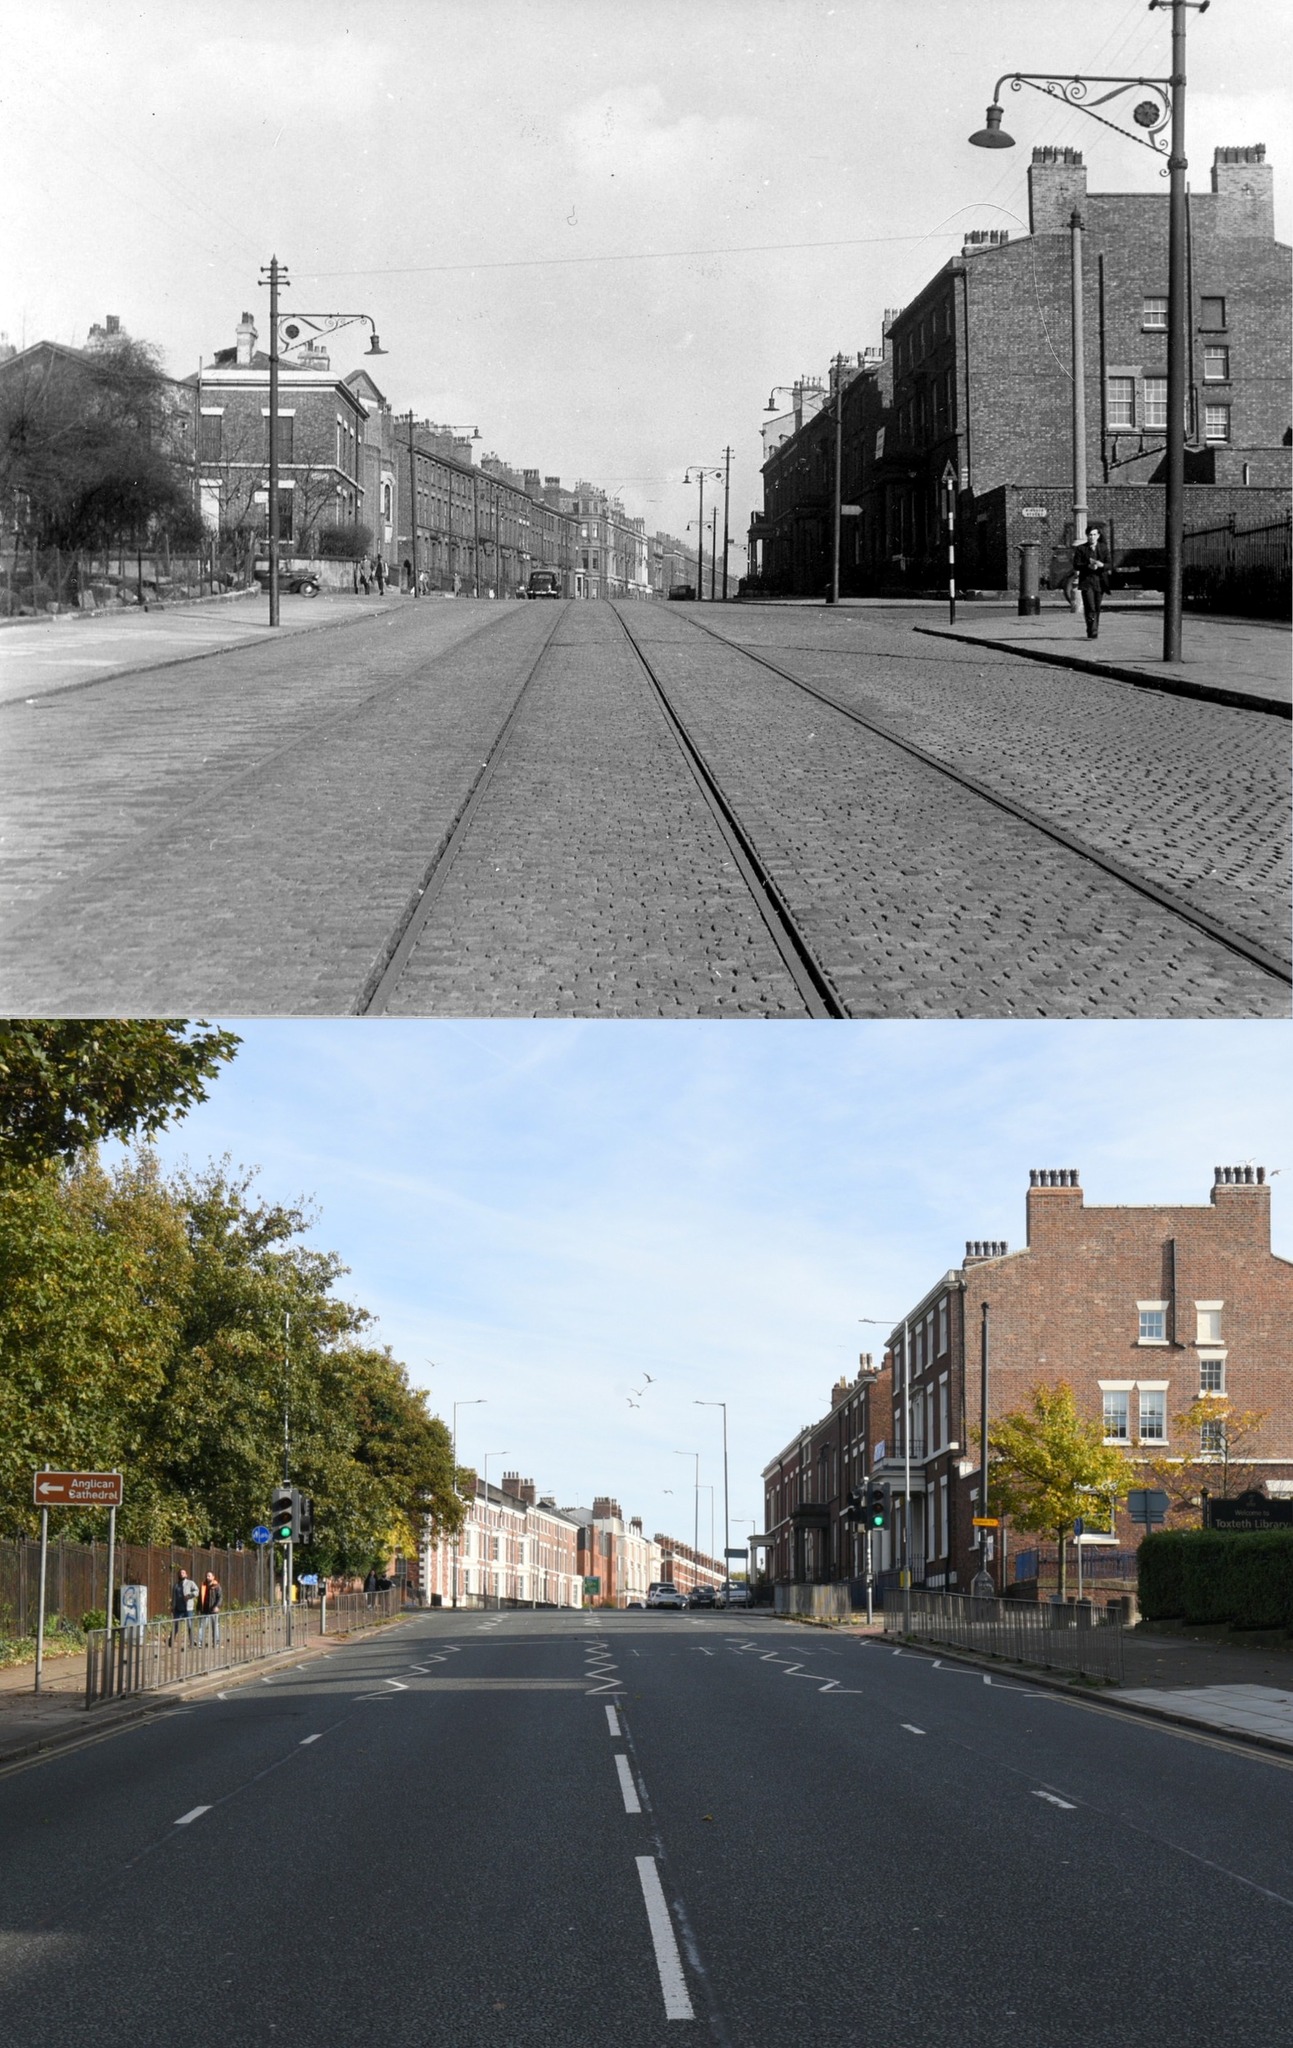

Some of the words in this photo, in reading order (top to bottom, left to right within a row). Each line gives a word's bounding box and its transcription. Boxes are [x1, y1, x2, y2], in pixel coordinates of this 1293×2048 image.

[71, 1479, 114, 1490] Anglican
[68, 1489, 118, 1499] Cathedral
[1215, 1519, 1252, 1528] Toxteth
[1254, 1519, 1289, 1529] Library
